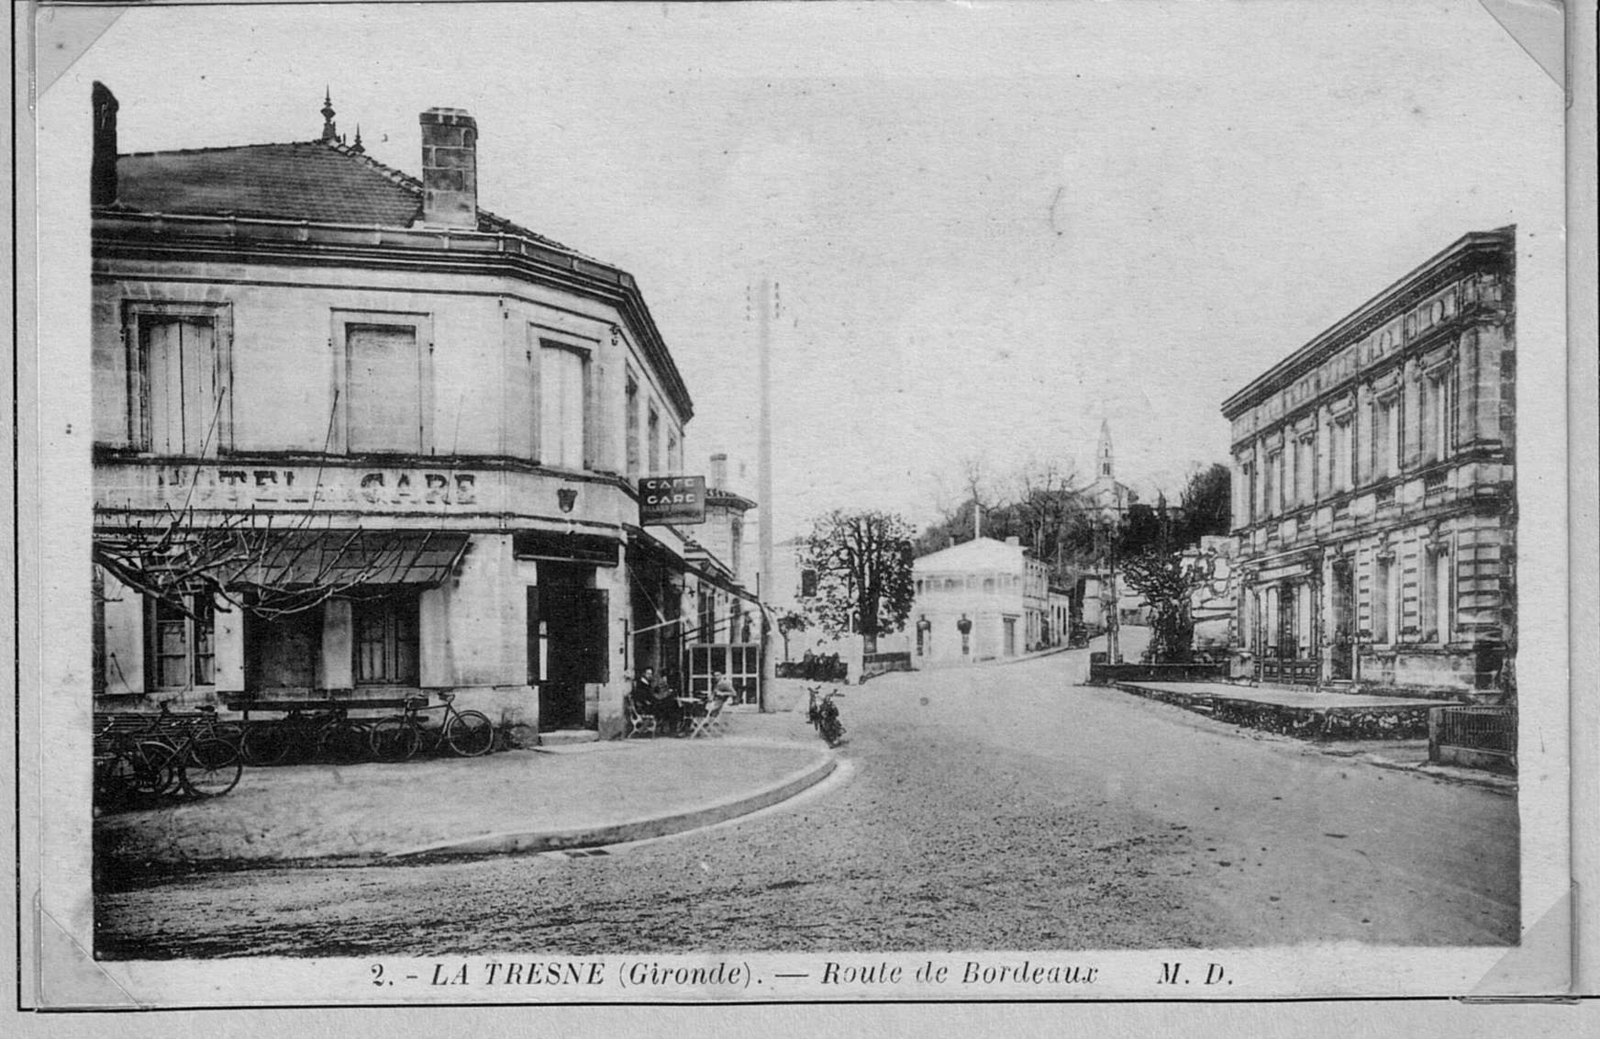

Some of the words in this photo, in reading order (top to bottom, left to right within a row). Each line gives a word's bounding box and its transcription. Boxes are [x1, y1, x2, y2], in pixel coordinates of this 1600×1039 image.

[360, 472, 477, 505] GARE
[646, 478, 696, 489] CAFE
[646, 493, 696, 505] GARE
